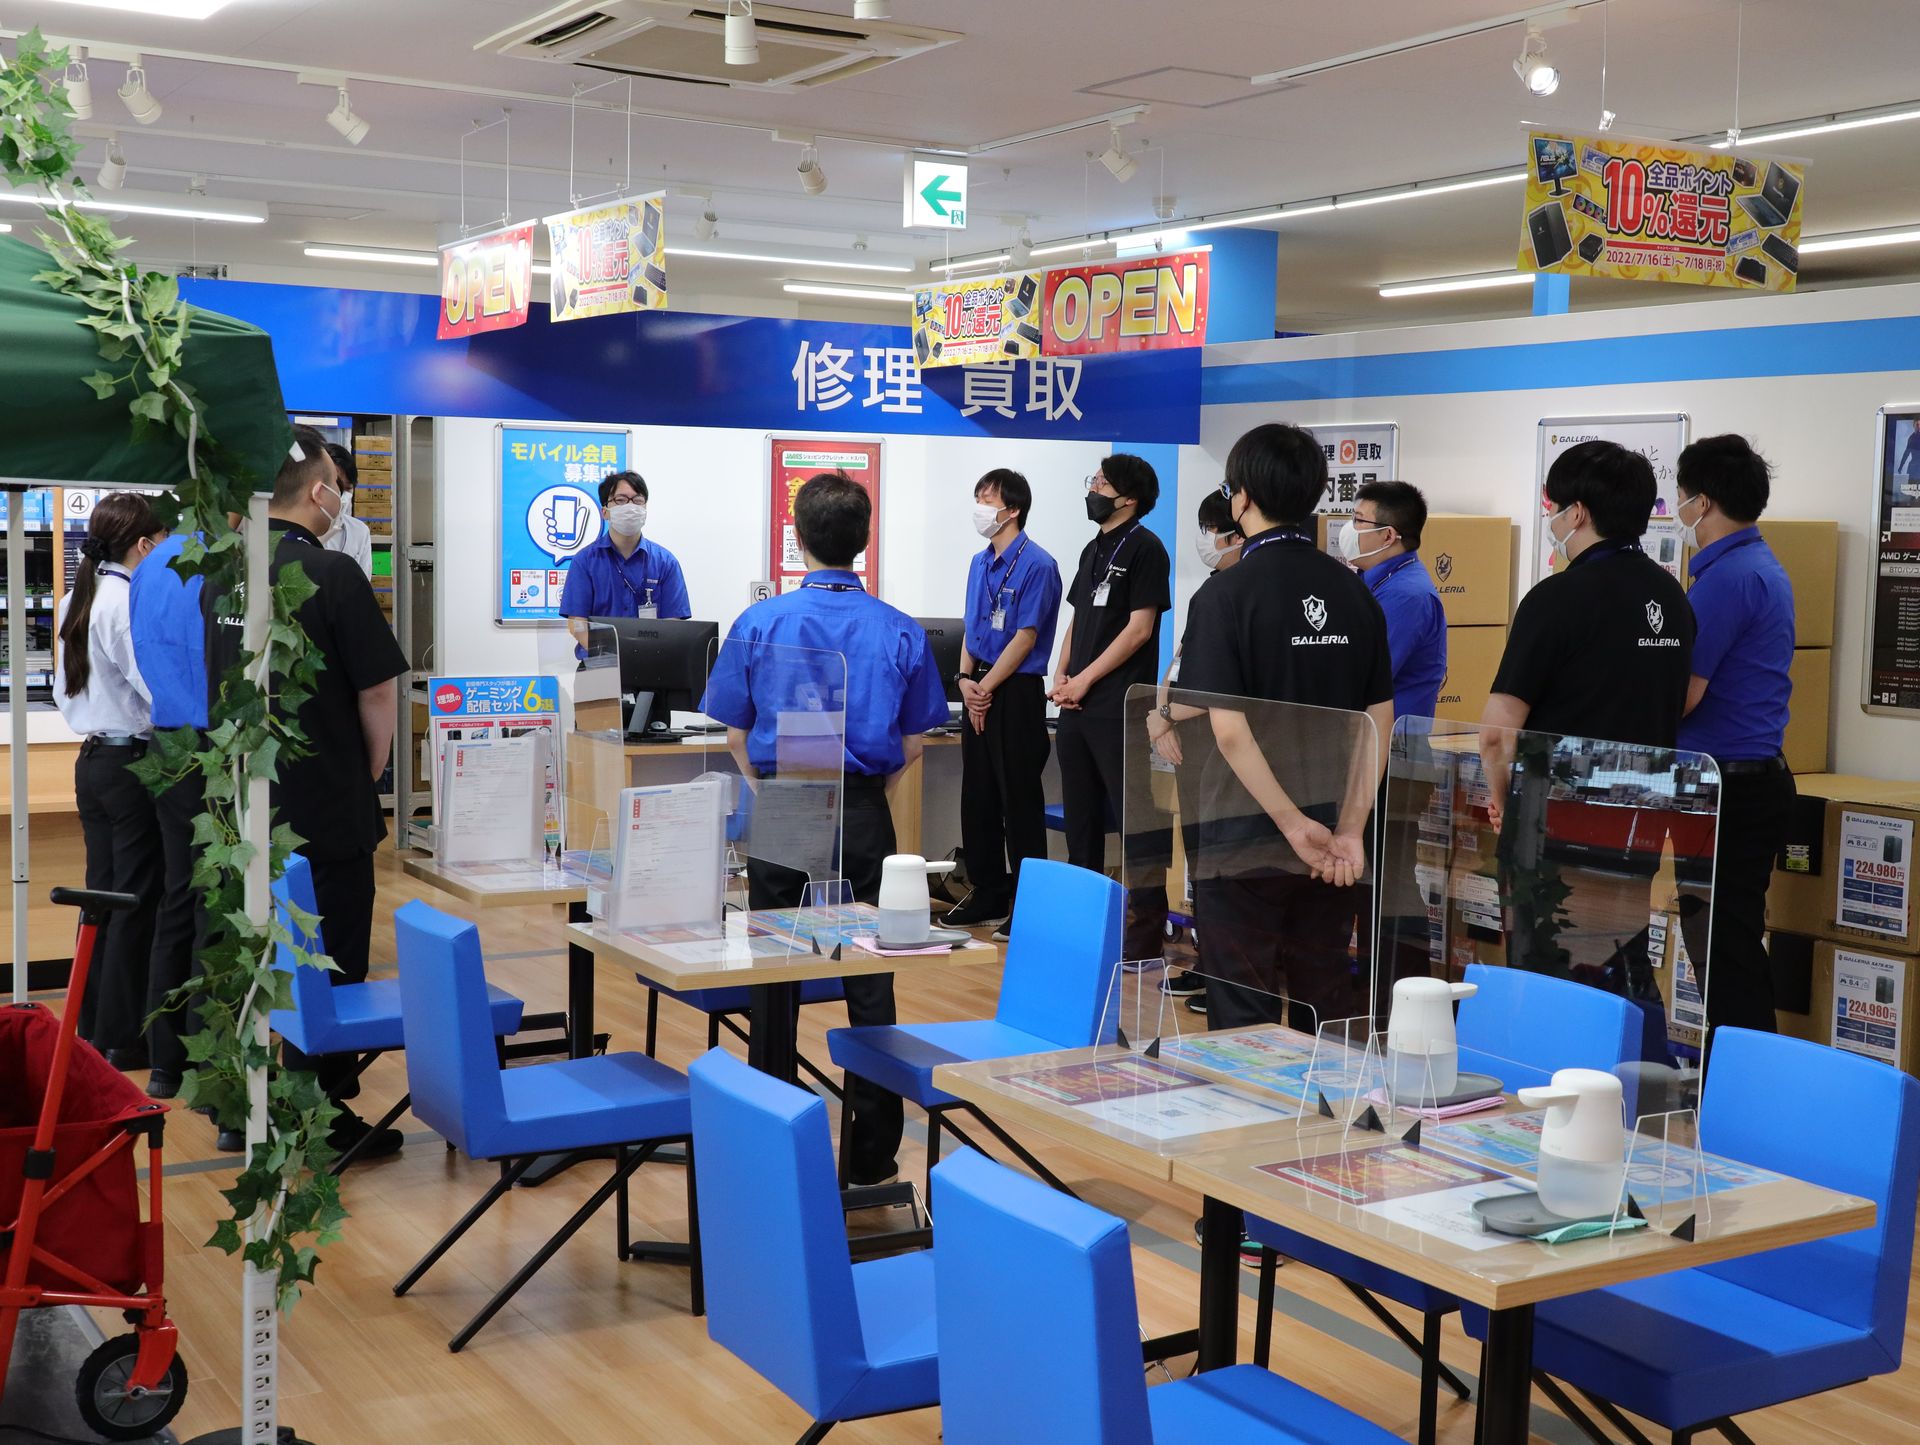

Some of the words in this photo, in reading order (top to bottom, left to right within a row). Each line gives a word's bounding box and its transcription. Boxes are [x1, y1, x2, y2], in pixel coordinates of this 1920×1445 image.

[1648, 163, 1733, 195] 全品ポイント
[1603, 159, 1729, 243] 10%還元
[446, 239, 530, 325] OPEN
[1052, 264, 1197, 343] OPEN
[791, 340, 923, 415] 修理
[960, 355, 1084, 422] 買取
[511, 442, 618, 465] モバイル会員
[1320, 444, 1335, 461] 理
[1357, 442, 1382, 461] 買取
[1880, 551, 1901, 561] AMD
[1436, 586, 1466, 594] LERIA
[1291, 635, 1349, 646] GALLERIA
[1638, 638, 1680, 647] GALLERIA
[437, 693, 461, 705] 理想の
[465, 686, 523, 700] ゲーミング
[466, 700, 522, 713] 配信セット
